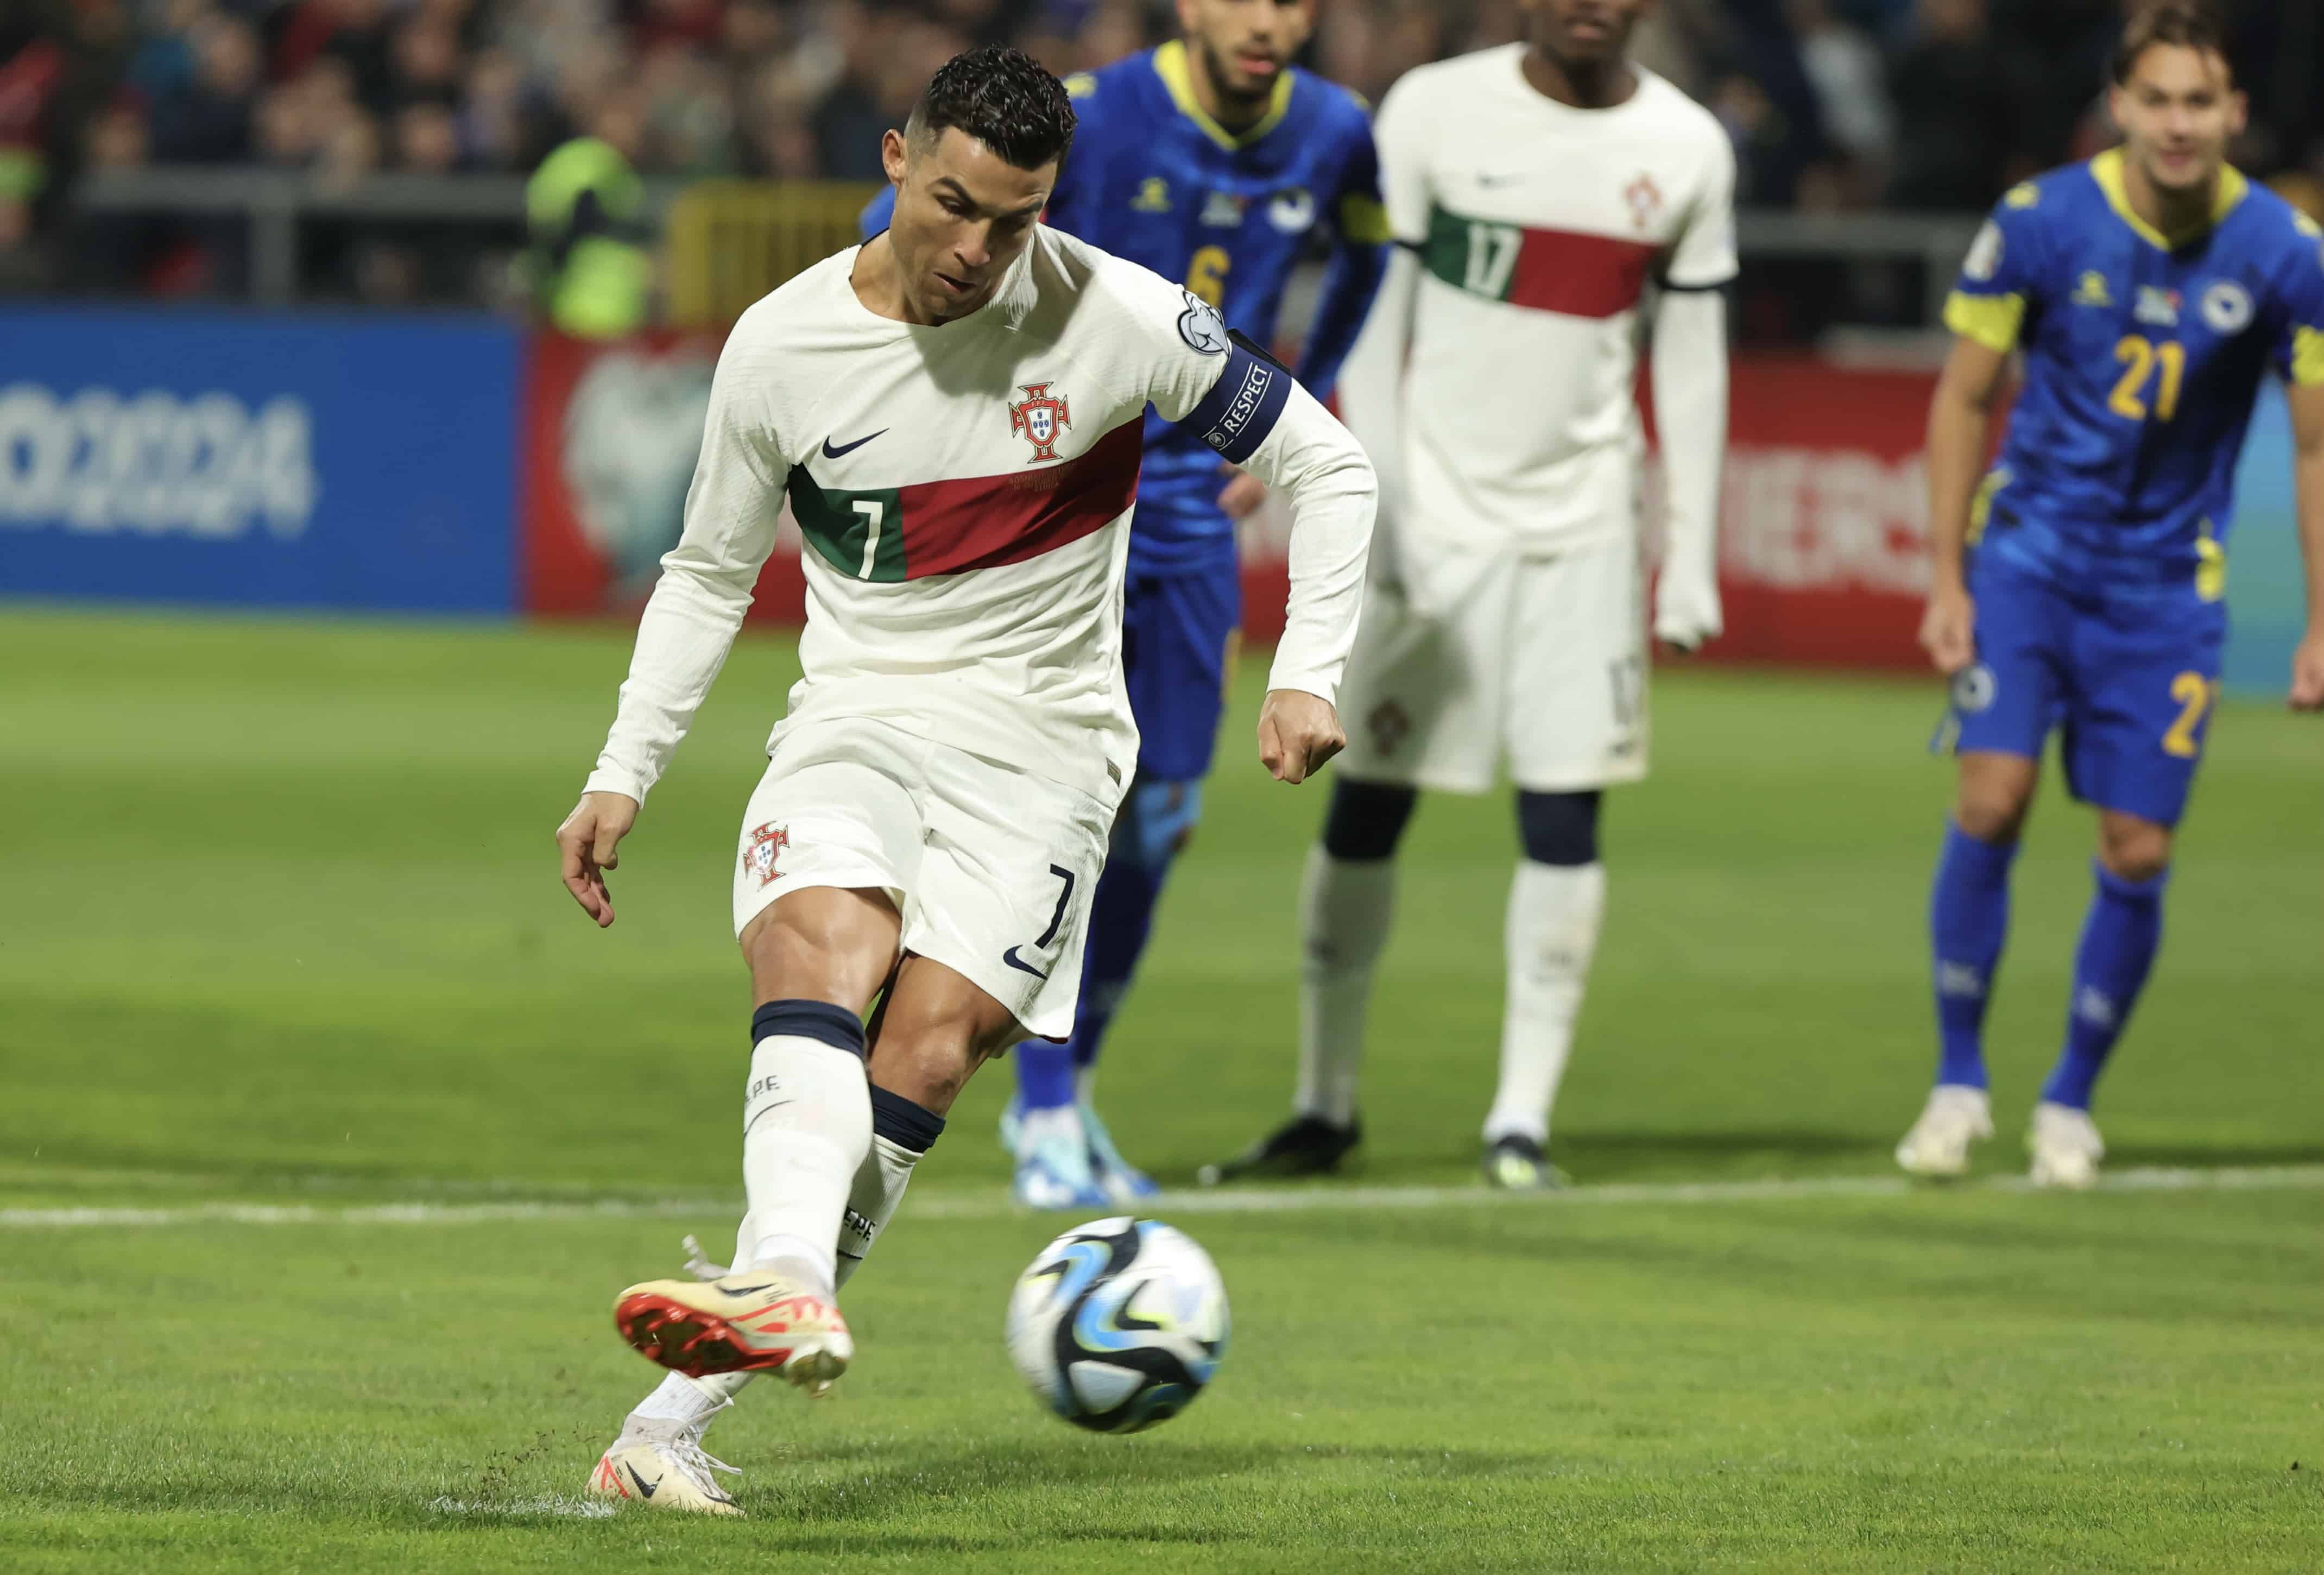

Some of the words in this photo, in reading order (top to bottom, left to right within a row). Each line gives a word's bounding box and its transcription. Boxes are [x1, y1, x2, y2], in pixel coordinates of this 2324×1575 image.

[1188, 245, 1231, 307] 6
[1465, 224, 1524, 297] 17
[1224, 365, 1267, 433] RESPECT
[2107, 335, 2186, 423] 21
[852, 500, 883, 580] 7
[1034, 863, 1075, 949] 7
